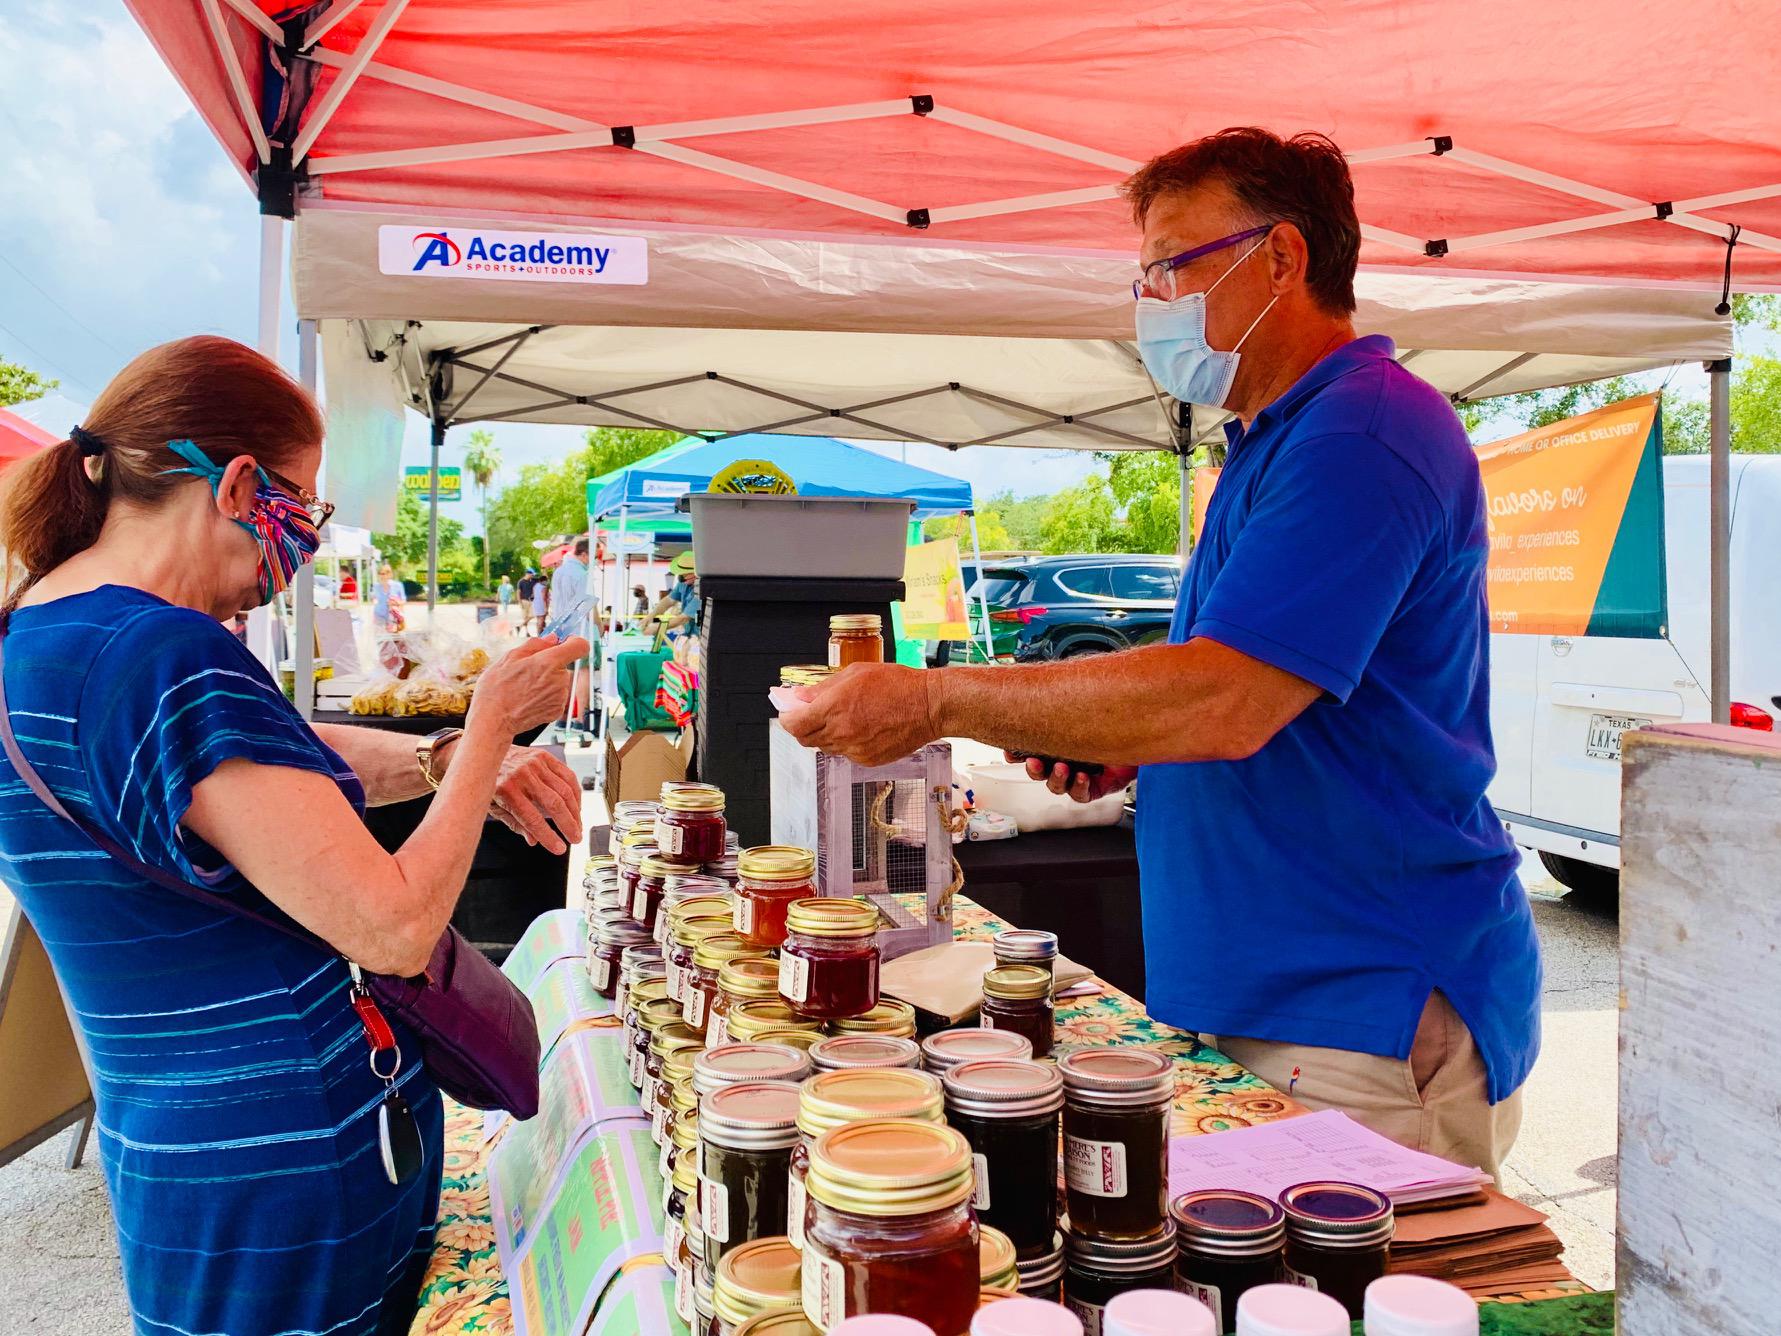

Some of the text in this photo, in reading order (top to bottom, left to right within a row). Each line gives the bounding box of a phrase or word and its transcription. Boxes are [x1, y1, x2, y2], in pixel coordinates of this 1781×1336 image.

[467, 237, 610, 273] Academy
[1535, 440, 1550, 451] OR
[1551, 434, 1588, 448] OFFICE
[1590, 421, 1640, 441] DELIVERY
[1561, 485, 1588, 509] on
[1490, 609, 1518, 622] .com
[1608, 719, 1632, 730] TEXAS
